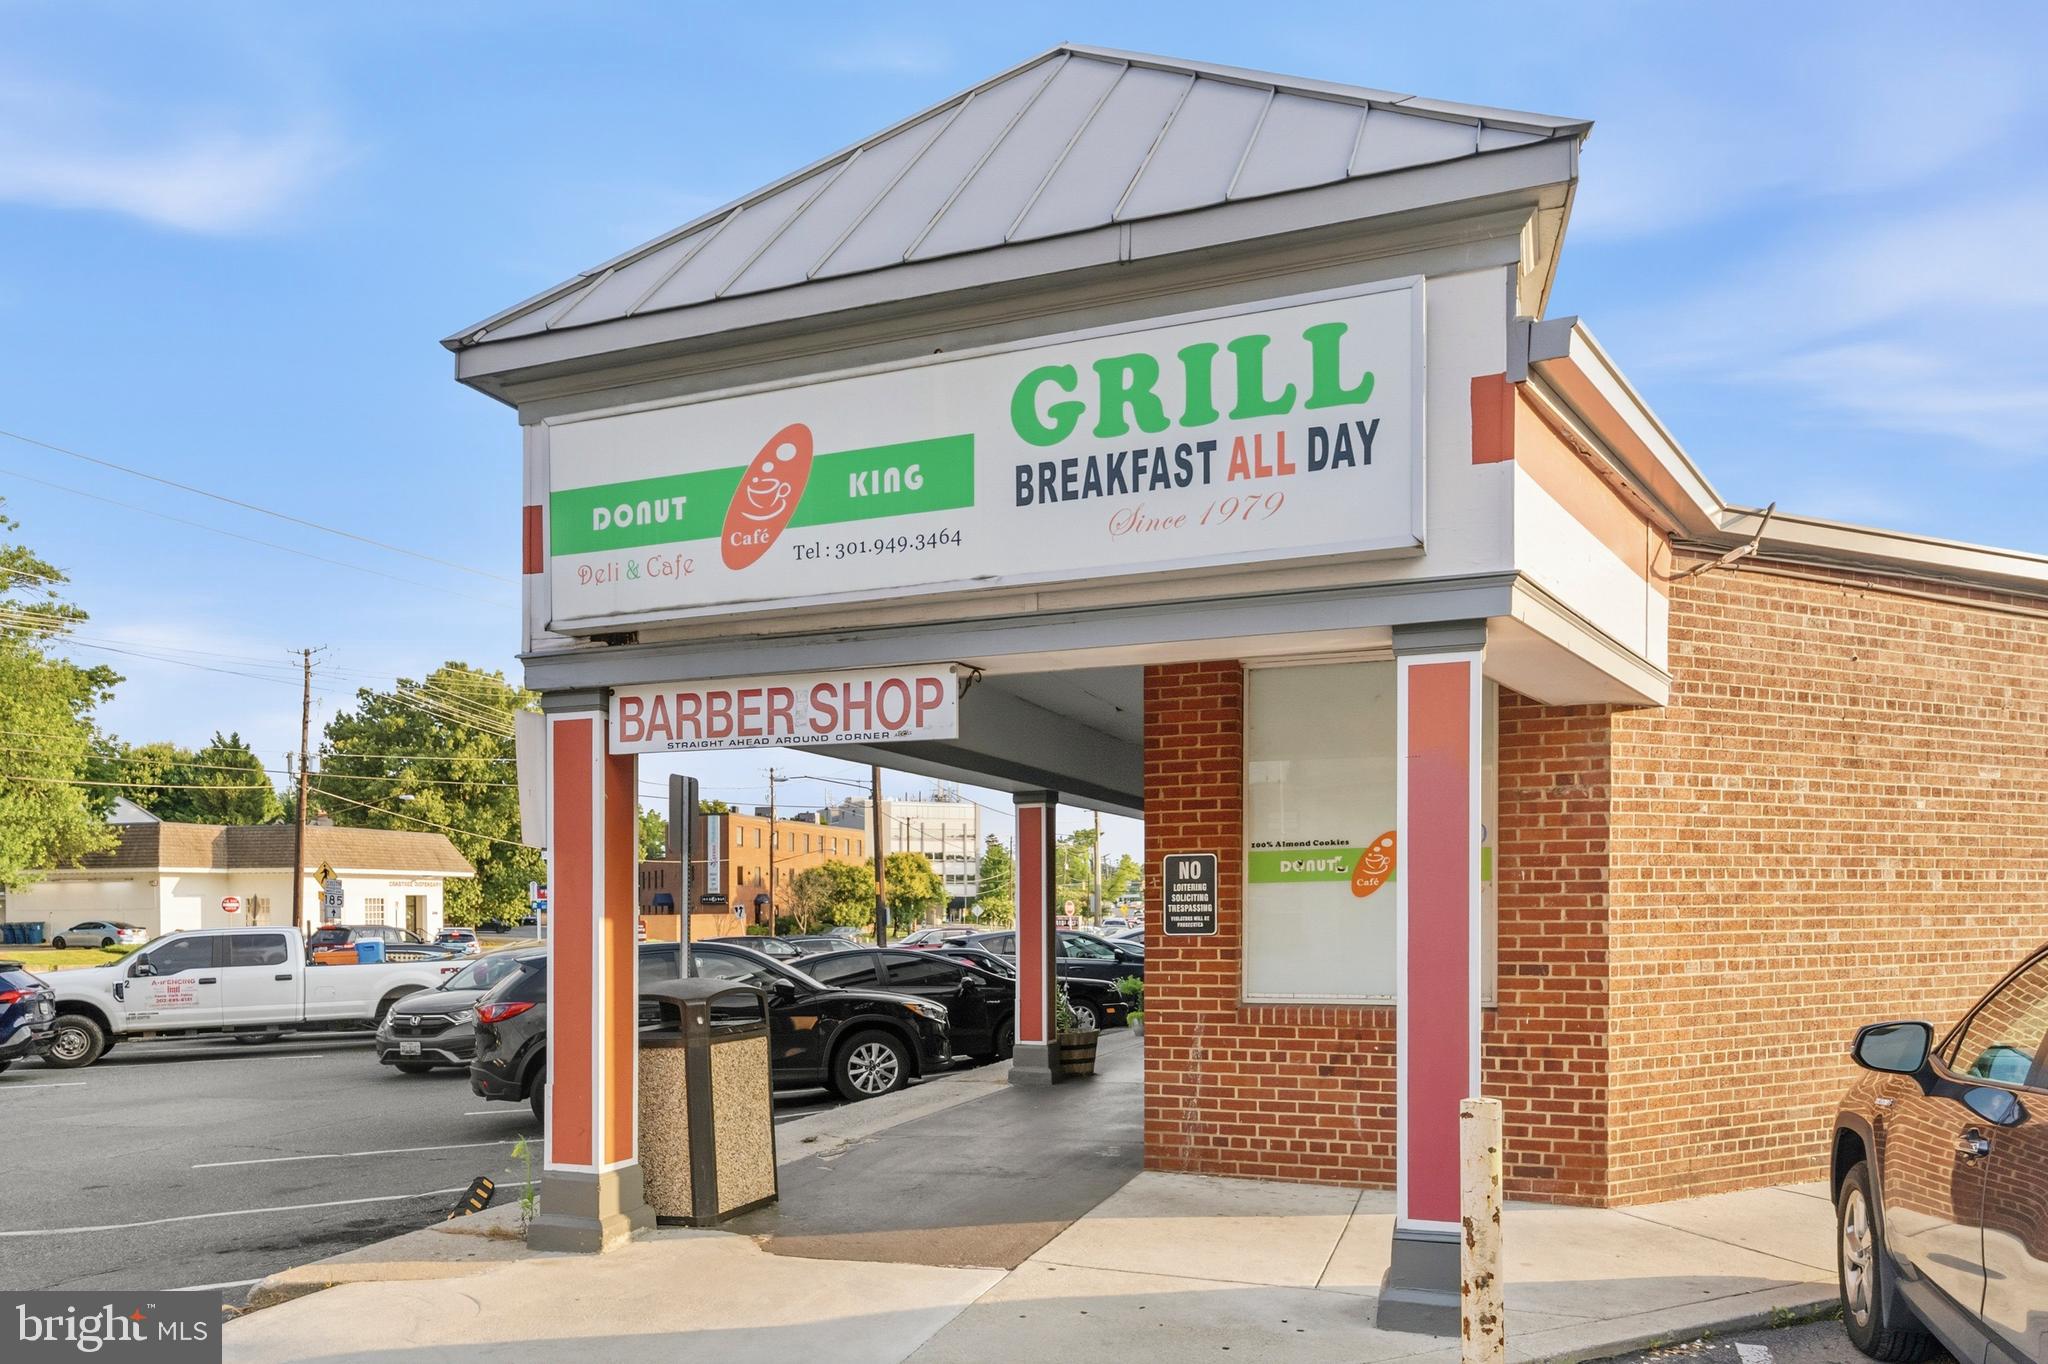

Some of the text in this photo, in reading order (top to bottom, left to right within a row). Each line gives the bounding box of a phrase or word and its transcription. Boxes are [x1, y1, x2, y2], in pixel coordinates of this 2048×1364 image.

[1010, 321, 1375, 447] GRILL
[1015, 418, 1380, 507] BREAKFAST ALL DAY
[592, 463, 924, 532] DONUT KING
[1108, 492, 1286, 541] Since 1979
[730, 528, 770, 548] Café
[834, 528, 963, 560] 301.949.3464
[577, 553, 696, 586] Deli & Cafe
[619, 677, 944, 743] BARBER SHOP
[667, 740, 724, 750] STRAIGHT
[729, 737, 770, 747] AHEAD
[775, 735, 829, 744] AROUND
[835, 731, 890, 742] CORNER
[1275, 839, 1311, 848] Almond
[1313, 838, 1350, 847] Cookies
[1178, 860, 1202, 880] NO
[1173, 883, 1207, 892] LOITERING
[1356, 878, 1380, 887] Café
[325, 895, 343, 906] 185
[1171, 893, 1209, 902] SOLICITING
[1168, 904, 1213, 913] TRESPASSING
